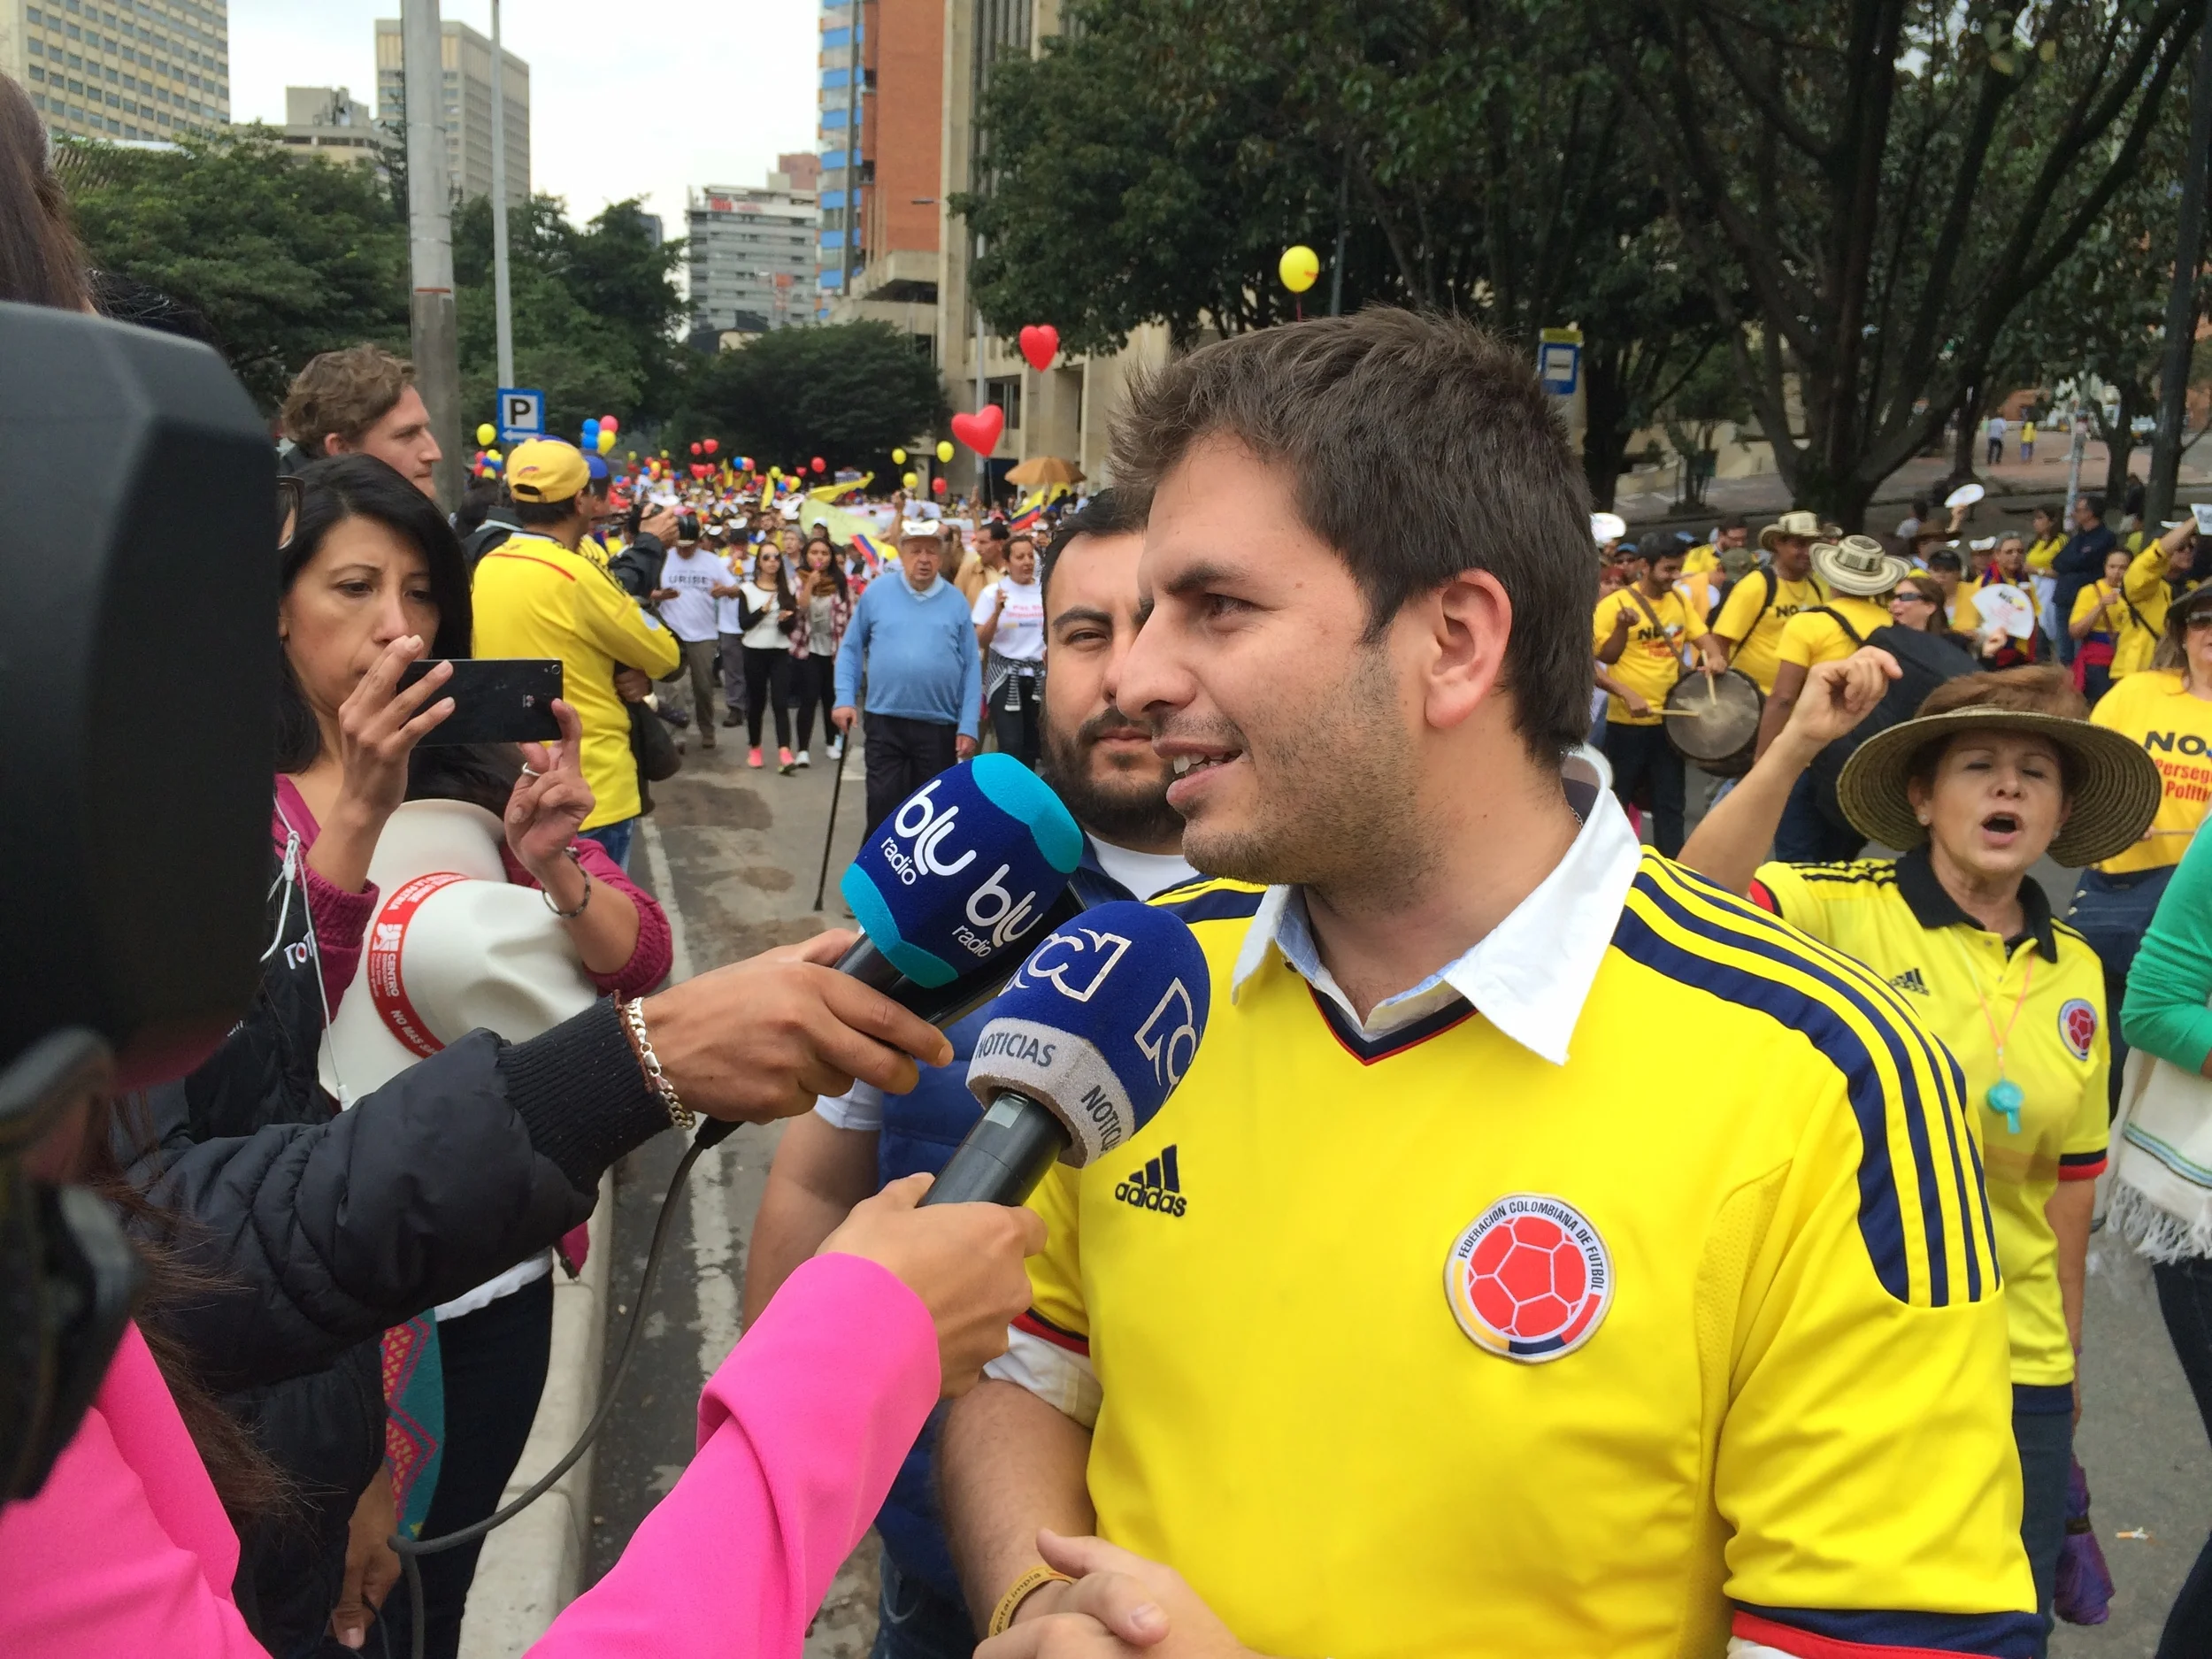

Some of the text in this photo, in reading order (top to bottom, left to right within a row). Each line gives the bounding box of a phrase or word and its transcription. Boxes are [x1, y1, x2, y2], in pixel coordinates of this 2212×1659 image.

[511, 399, 531, 425] P
[2144, 731, 2206, 755] NO
[2154, 759, 2212, 784] Perseg
[895, 780, 977, 876] blu
[880, 837, 917, 886] radio
[966, 864, 1043, 948] blu
[952, 925, 992, 957] radio
[388, 953, 400, 996] CENTRO
[974, 1033, 1056, 1067] NOTICIAS
[1115, 1181, 1187, 1217] adidas
[1509, 1201, 1578, 1232] COLOMBIANA
[1576, 1228, 1593, 1245] DE
